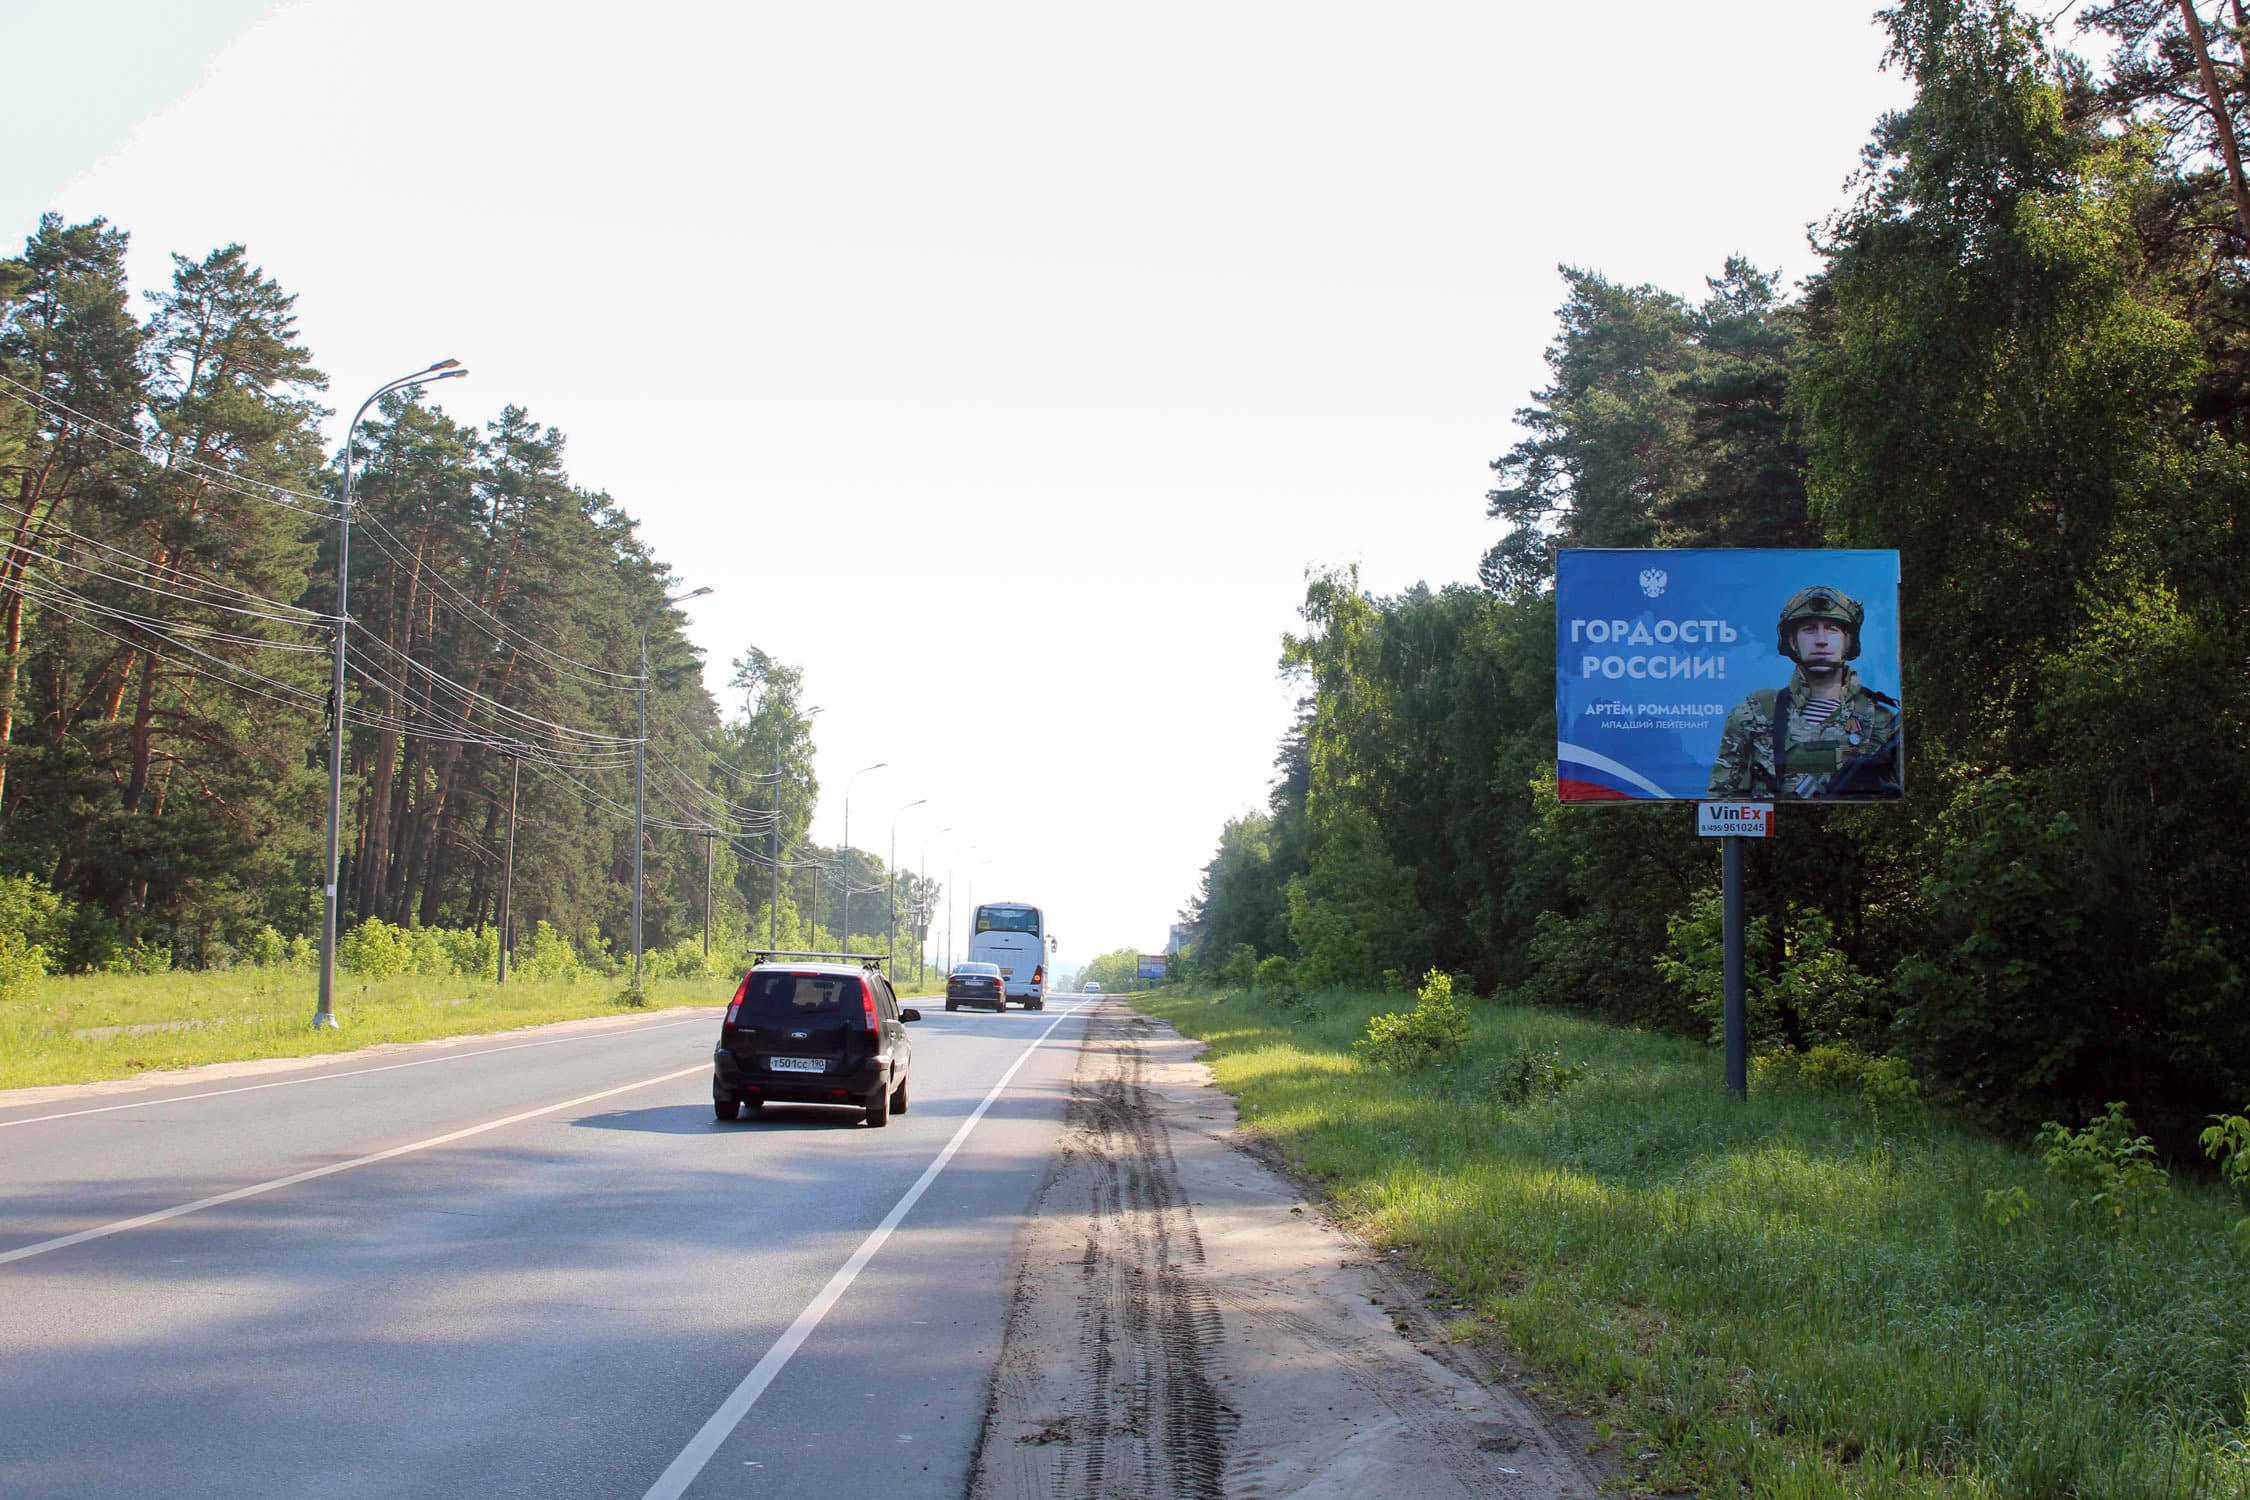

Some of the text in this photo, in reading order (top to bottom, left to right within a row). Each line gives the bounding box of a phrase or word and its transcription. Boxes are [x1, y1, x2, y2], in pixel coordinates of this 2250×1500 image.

[1572, 620, 1736, 645] ГОРДОСТЬ
[1583, 656, 1725, 679] РОССИИ!
[1585, 700, 1724, 717] АРТЁМ РОМАНЦОВ
[1601, 719, 1709, 730] МЛАДШИЙ ЛЕЙТЕНАНТ
[1709, 806, 1761, 820] VinEx
